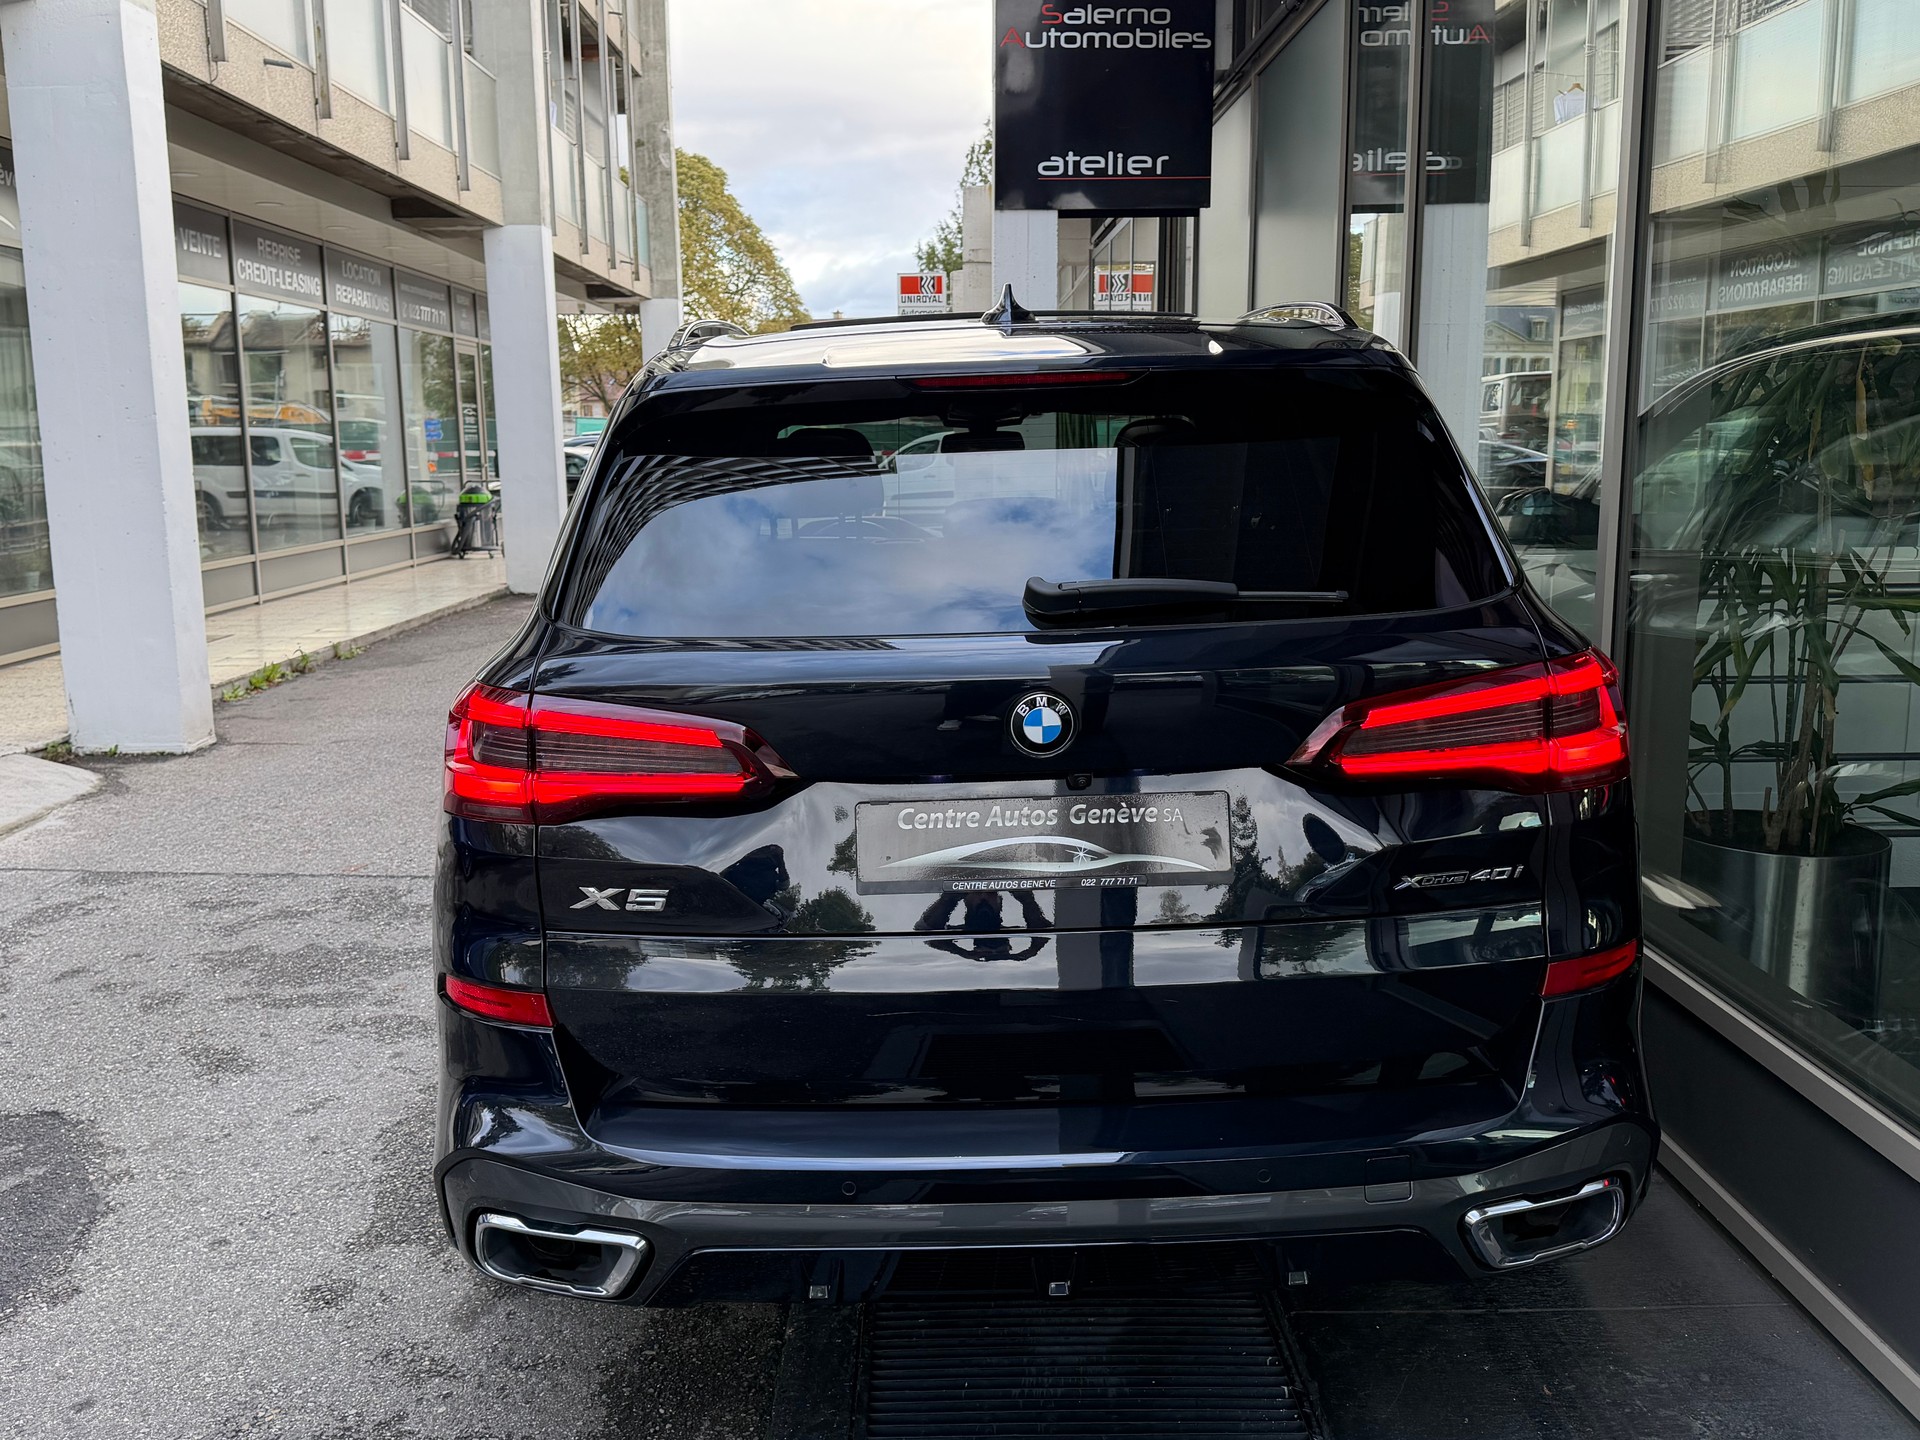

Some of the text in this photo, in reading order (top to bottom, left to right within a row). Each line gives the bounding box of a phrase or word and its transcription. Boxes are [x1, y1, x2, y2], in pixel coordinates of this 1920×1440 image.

[1042, 3, 1171, 24] Salerno
[1000, 27, 1212, 48] Automobiles
[1037, 151, 1169, 176] atelier
[179, 227, 222, 258] VENTE
[256, 237, 301, 266] REPRISE
[237, 258, 321, 296] CREDIT-LEASING
[341, 260, 381, 286] LOCATION
[335, 283, 390, 313] REPARATIONS
[900, 295, 943, 304] UNIROYAL
[1017, 696, 1068, 716] BMW
[898, 803, 1184, 830] Centre Autos Genève SA
[952, 881, 987, 890] CENTRE
[988, 881, 1019, 889] AUTOS
[1020, 880, 1056, 889] GENEVE
[1081, 879, 1096, 887] 022
[1100, 878, 1115, 886] 777
[1128, 877, 1138, 885] 71
[569, 886, 670, 912] X5
